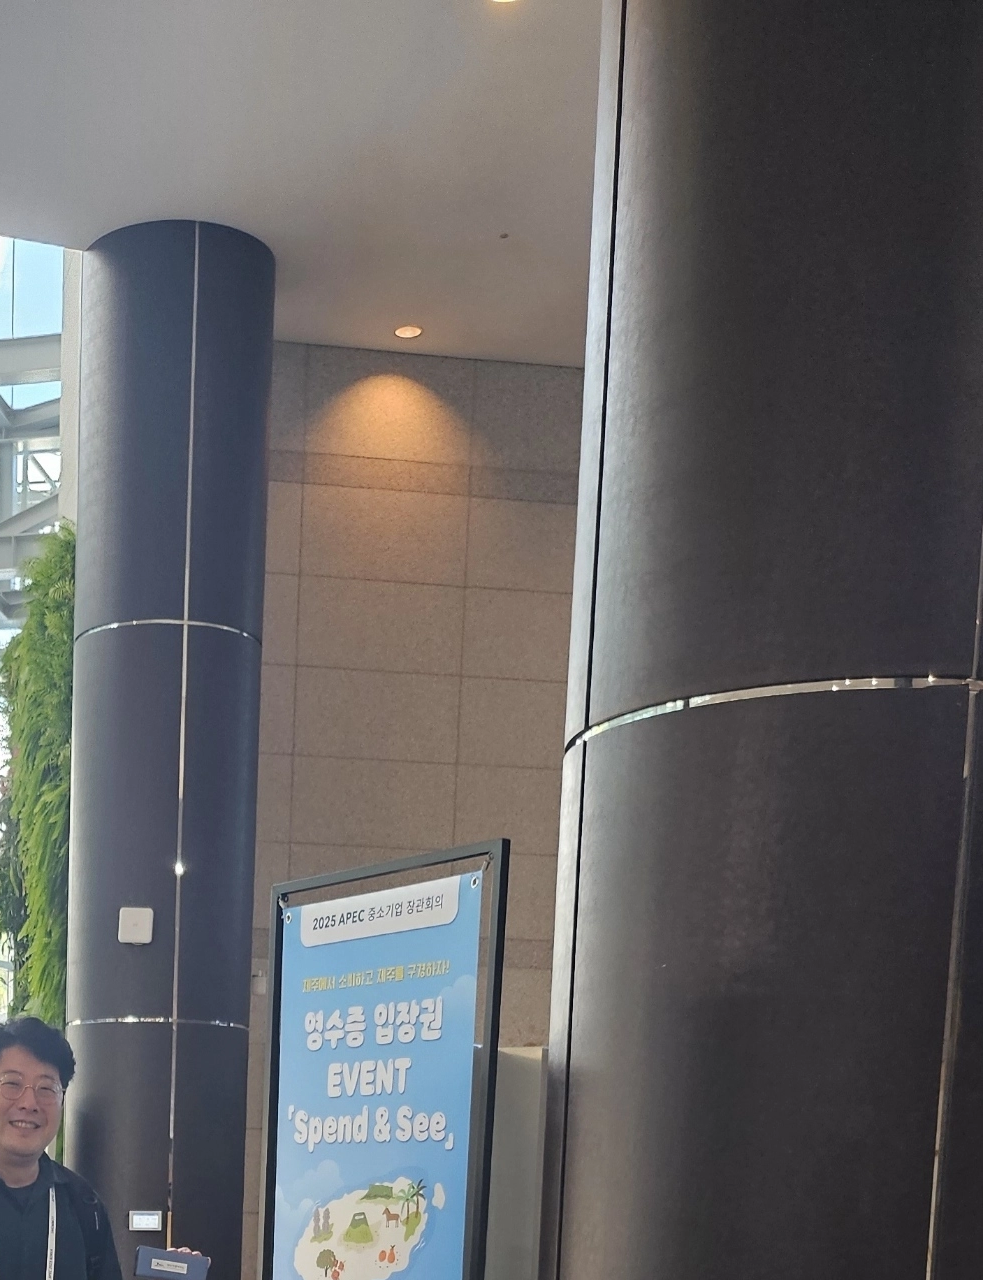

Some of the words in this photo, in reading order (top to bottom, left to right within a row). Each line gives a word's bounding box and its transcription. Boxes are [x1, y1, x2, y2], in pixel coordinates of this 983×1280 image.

[312, 915, 337, 931] 2025
[338, 910, 365, 926] APEC
[367, 903, 403, 922] 중소기업
[406, 894, 444, 915] 장관회의
[302, 976, 336, 994] 제주에서
[338, 971, 373, 989] 소비하고
[376, 966, 405, 984] 제주를
[407, 960, 450, 980] 구경하자!
[304, 1005, 367, 1051] 영수증
[373, 996, 443, 1045] 입장권
[327, 1057, 412, 1098] EVENT
[373, 1106, 391, 1143] &
